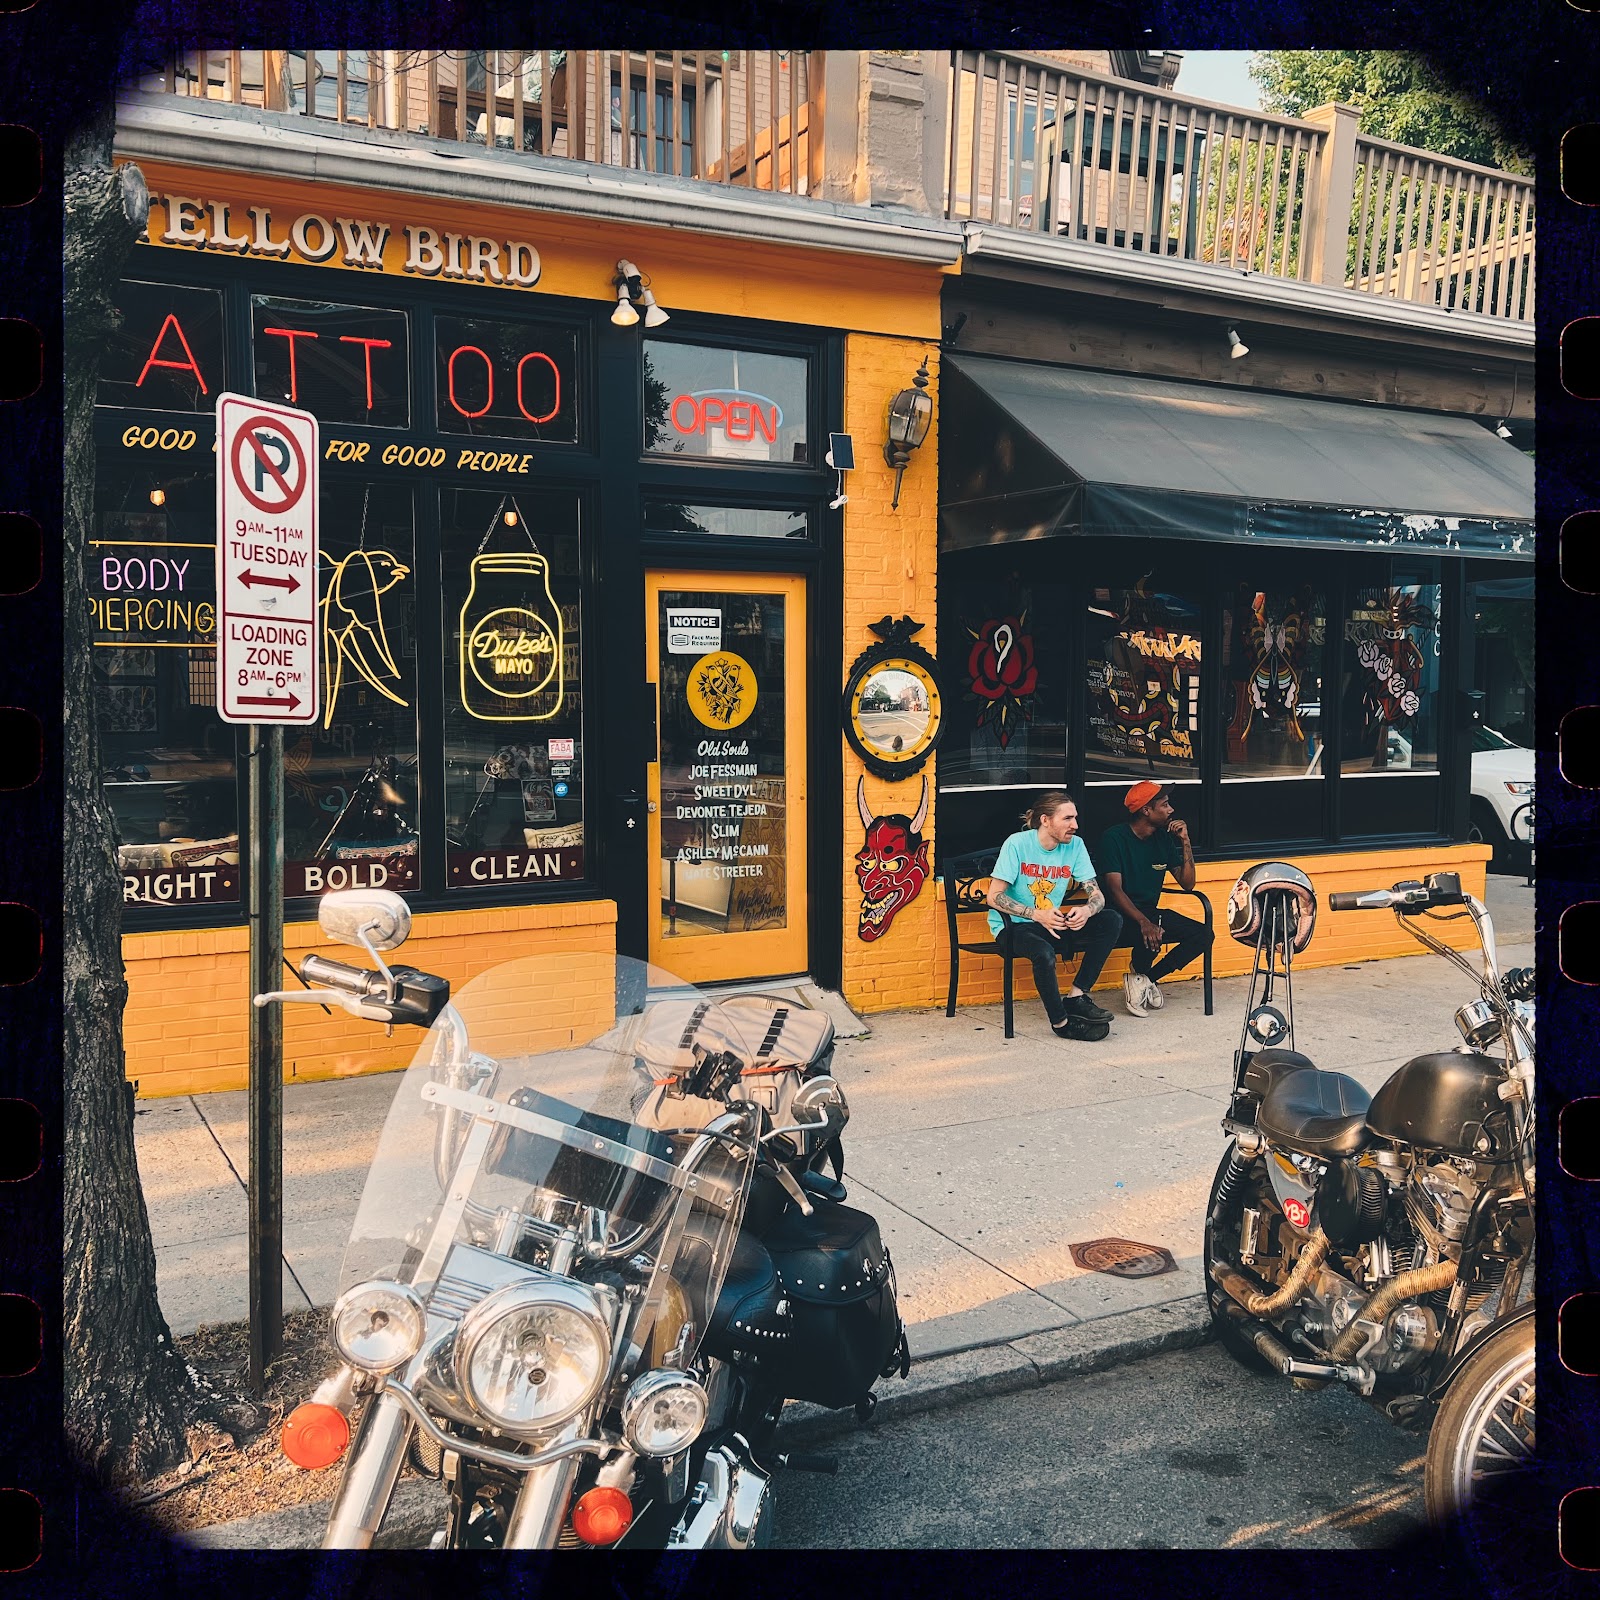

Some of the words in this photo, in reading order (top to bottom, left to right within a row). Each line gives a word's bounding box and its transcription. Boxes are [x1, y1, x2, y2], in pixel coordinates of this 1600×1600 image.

[141, 191, 390, 270] ELLOW
[401, 224, 542, 288] BIRD
[670, 394, 778, 445] OPEN
[122, 425, 196, 451] GOOD
[325, 440, 371, 463] FOR
[382, 444, 446, 468] GOOD
[457, 449, 535, 474] PEOPLE
[230, 541, 309, 568] TUESDAY
[102, 557, 190, 592] BODY
[673, 616, 717, 627] NOTICE
[231, 623, 308, 647] LOADING
[473, 629, 553, 659] Duke's
[246, 647, 294, 667] ZONE
[495, 657, 533, 674] MAYO
[697, 740, 722, 757] Old
[721, 739, 750, 757] Souls
[688, 765, 709, 781] JOE
[710, 763, 758, 780] FESSMAN
[694, 784, 733, 801] SWEET
[733, 784, 757, 799] DYL
[676, 805, 727, 820] DEVONTE
[728, 803, 768, 817] TEJEDA
[711, 824, 740, 840] SLIM
[676, 847, 722, 863] ASHLEY
[470, 853, 562, 881] CLEAN
[712, 864, 764, 881] STREETER
[1020, 861, 1072, 880] MELVINS
[304, 863, 389, 893] BOLD
